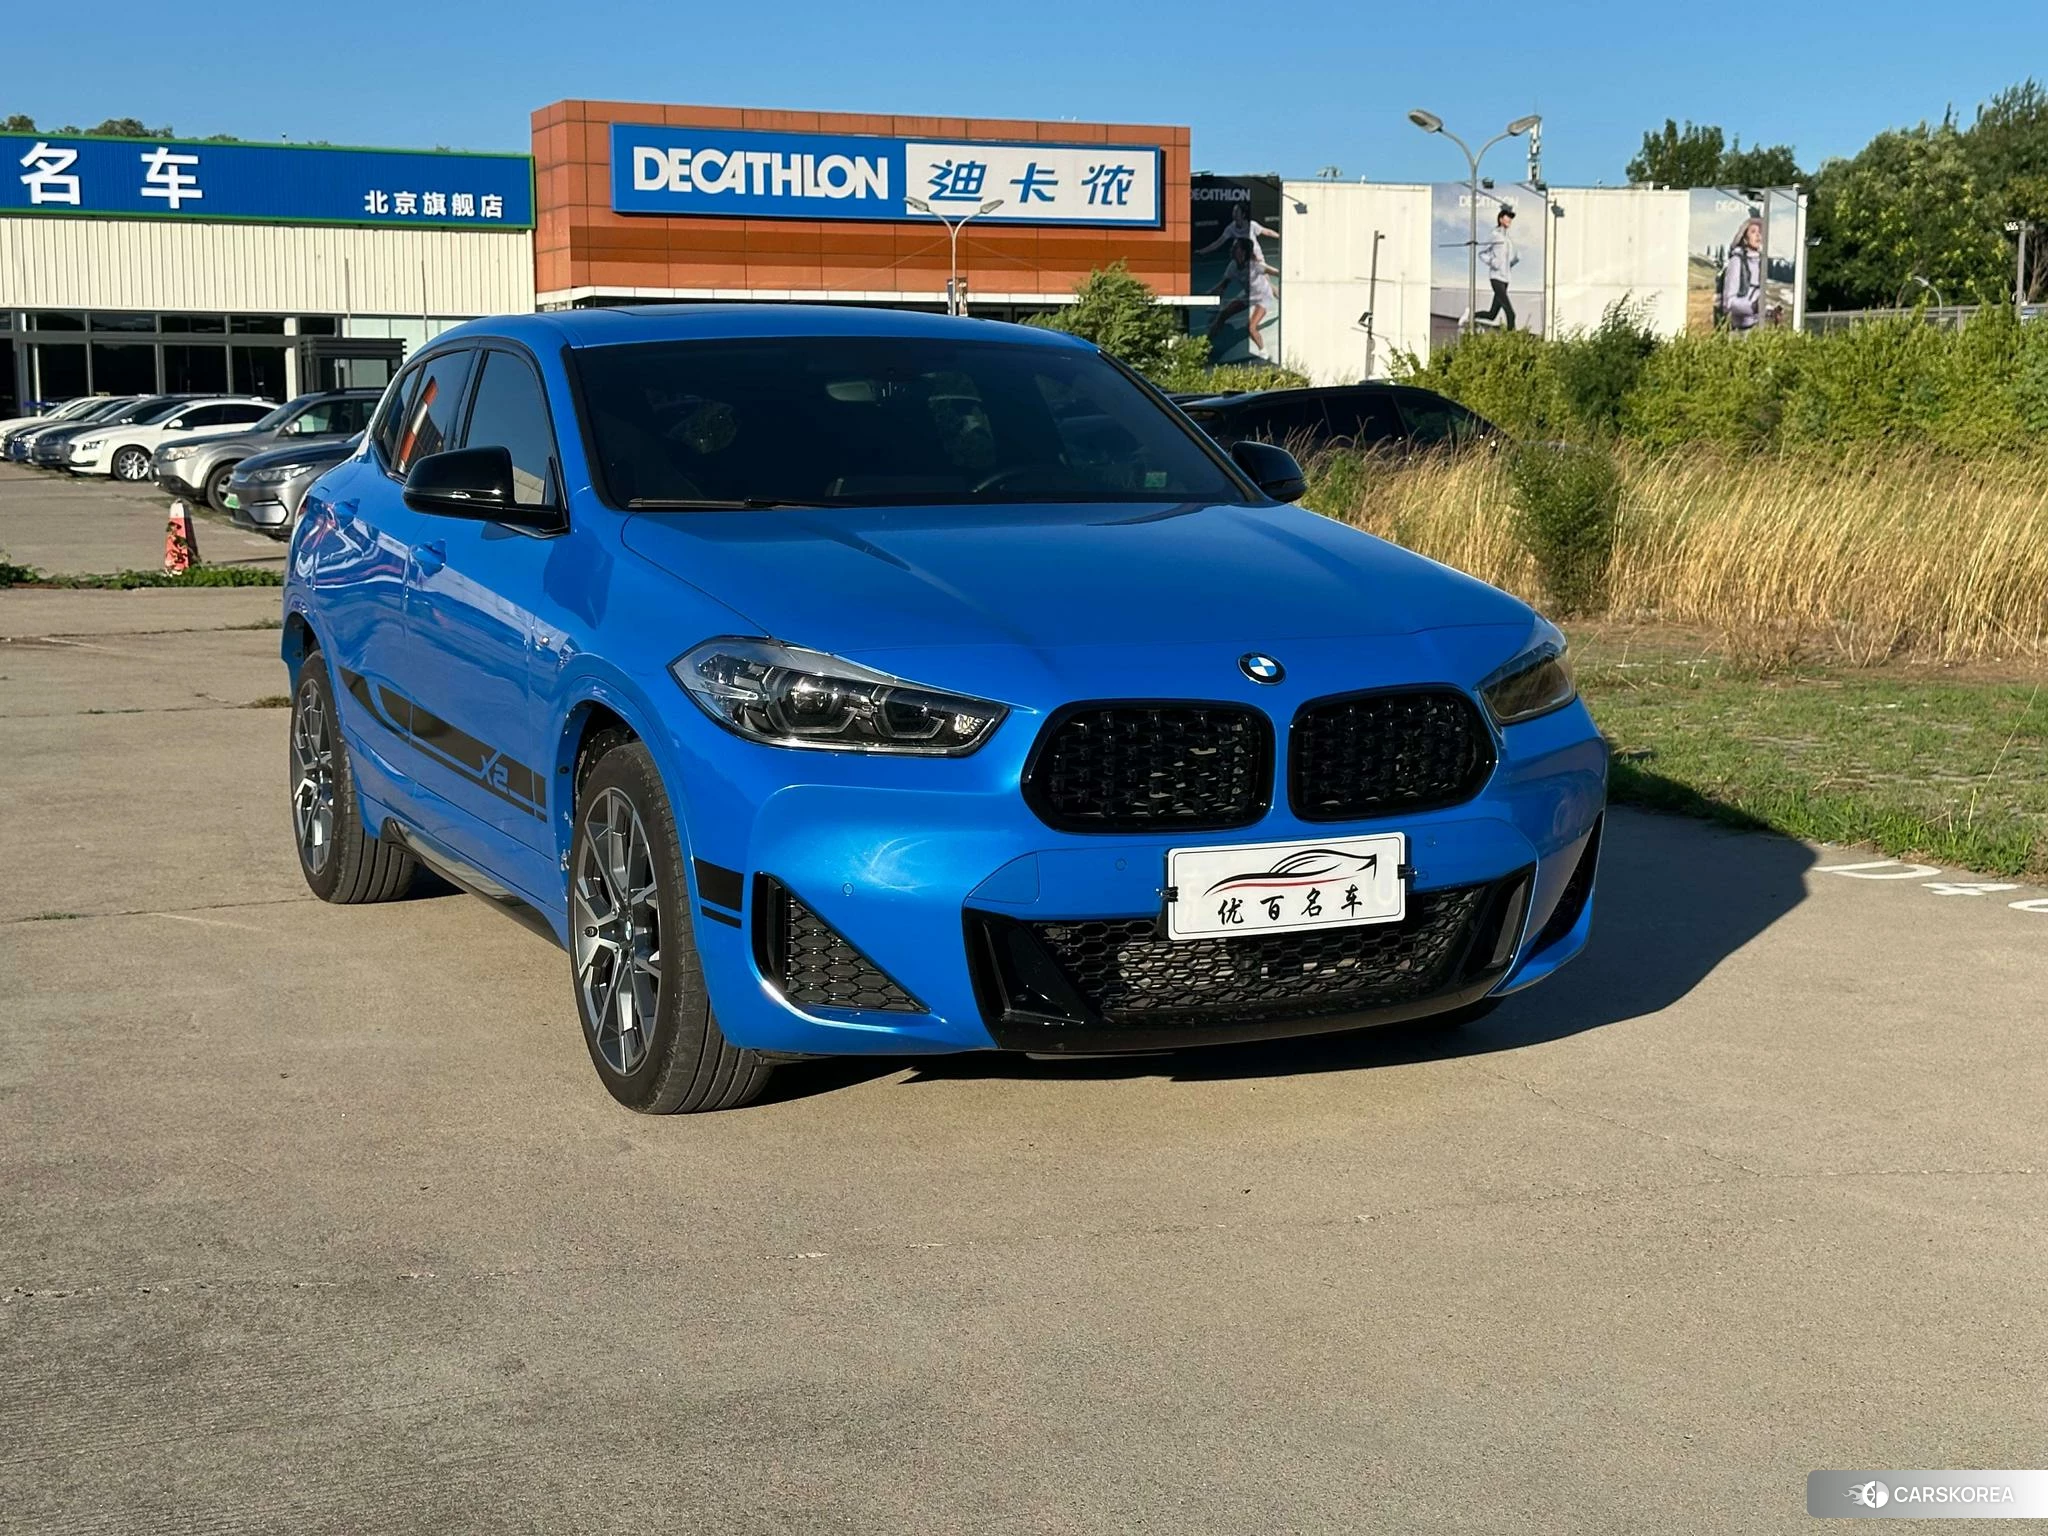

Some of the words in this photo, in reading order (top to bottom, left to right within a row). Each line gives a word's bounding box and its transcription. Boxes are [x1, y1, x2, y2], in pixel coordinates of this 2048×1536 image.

[20, 142, 203, 209] 名车
[633, 146, 889, 200] DECATHLON
[928, 159, 1135, 206] 迪卡侬
[364, 190, 503, 218] 北京旗舰店
[1217, 884, 1363, 925] 优百名车
